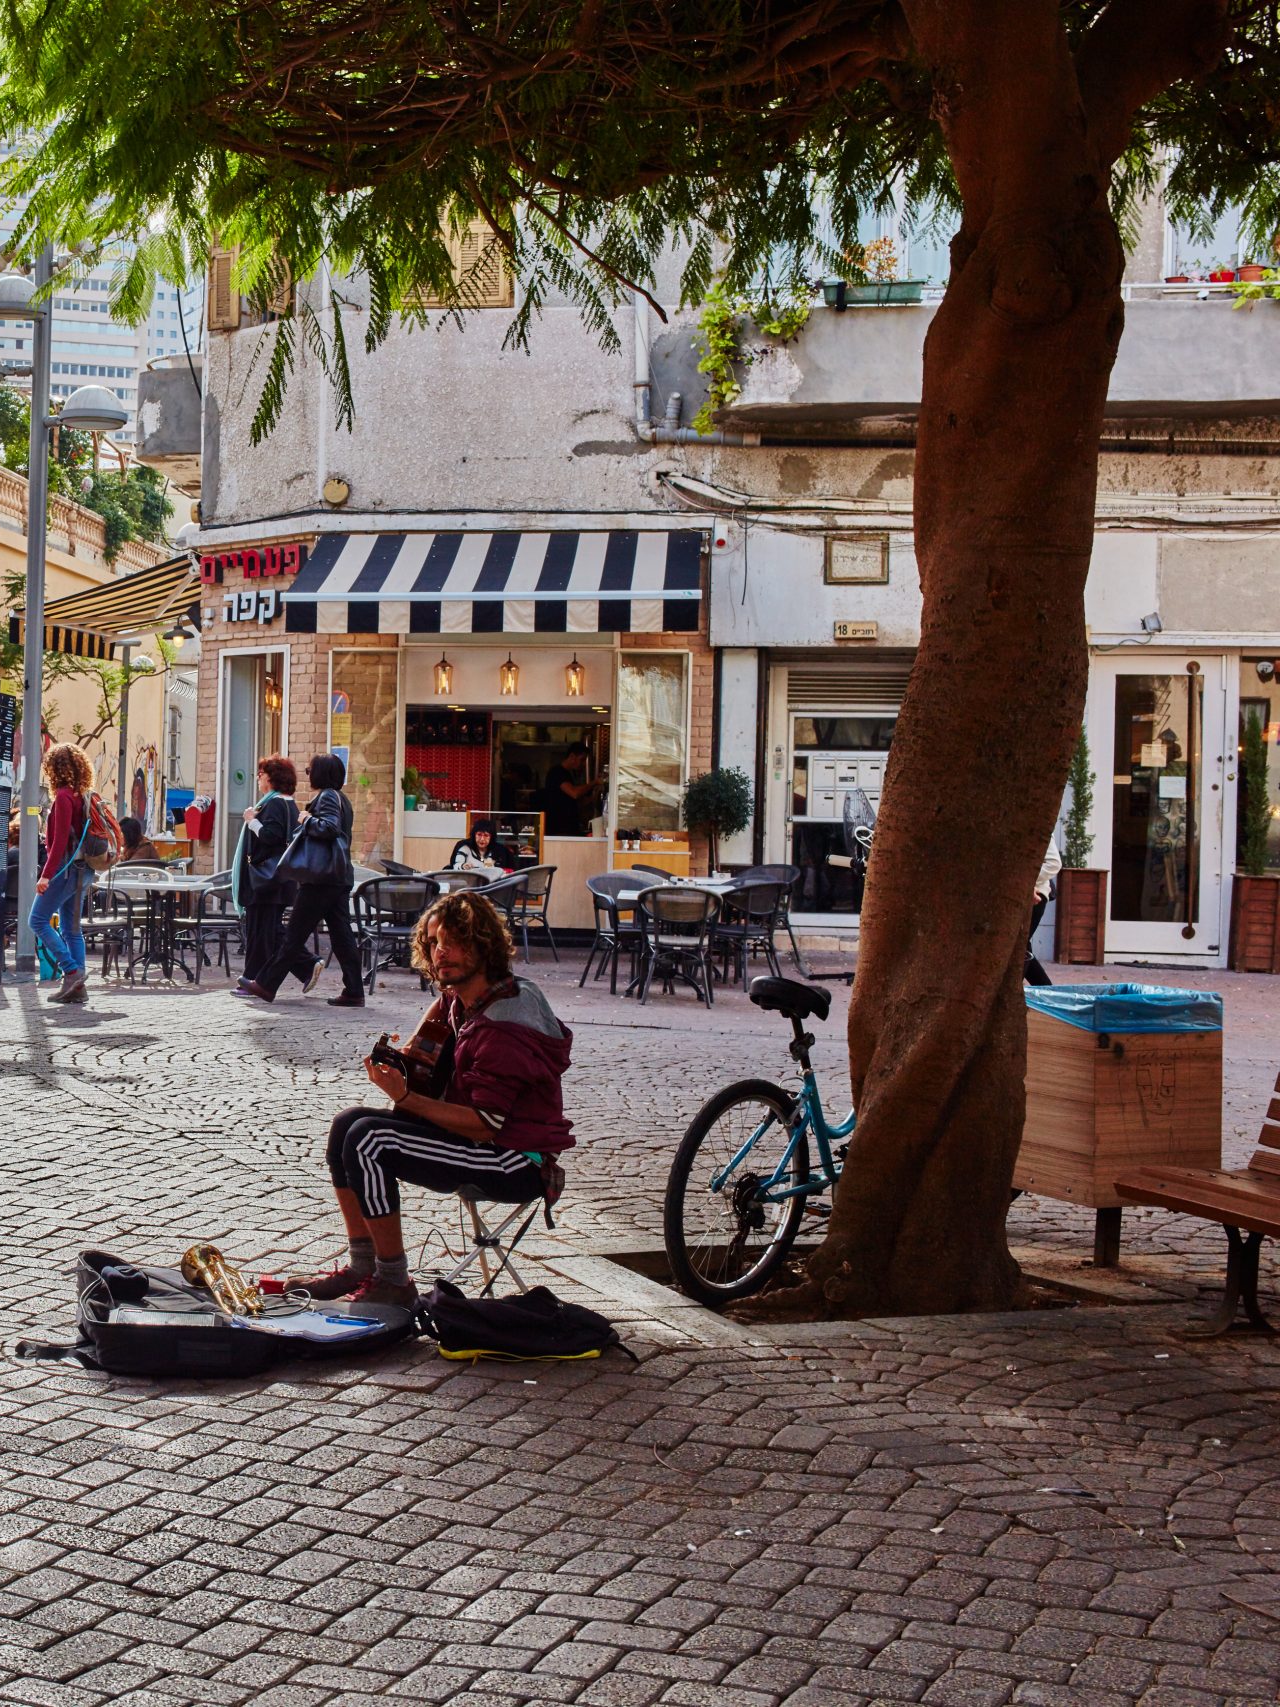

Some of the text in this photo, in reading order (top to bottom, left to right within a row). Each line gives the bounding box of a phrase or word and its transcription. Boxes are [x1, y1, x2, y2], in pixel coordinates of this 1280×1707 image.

[200, 543, 301, 585] פעמיים
[222, 588, 277, 625] קפה
[837, 624, 848, 636] 18
